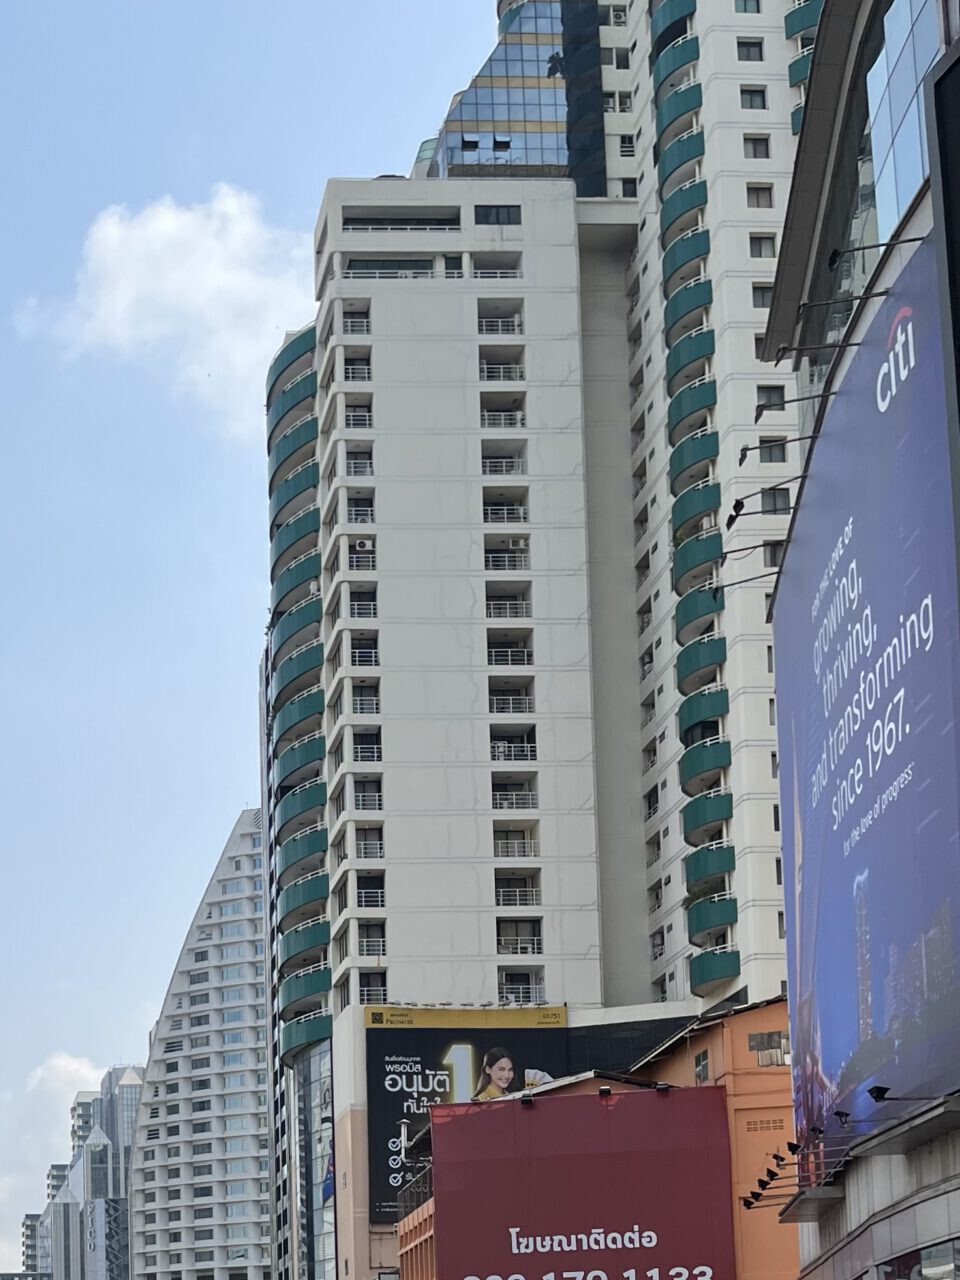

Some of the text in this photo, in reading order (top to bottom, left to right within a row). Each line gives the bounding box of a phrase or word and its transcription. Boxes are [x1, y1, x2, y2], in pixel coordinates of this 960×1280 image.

[877, 321, 915, 413] citi
[844, 516, 853, 545] OF
[813, 558, 862, 684] growing,
[823, 604, 877, 718] thriving,
[812, 593, 934, 808] and transforming
[832, 687, 910, 831] since 1967.
[384, 1069, 451, 1099] อนุมัติ
[509, 1225, 657, 1254] โฆษณาติดต่อ
